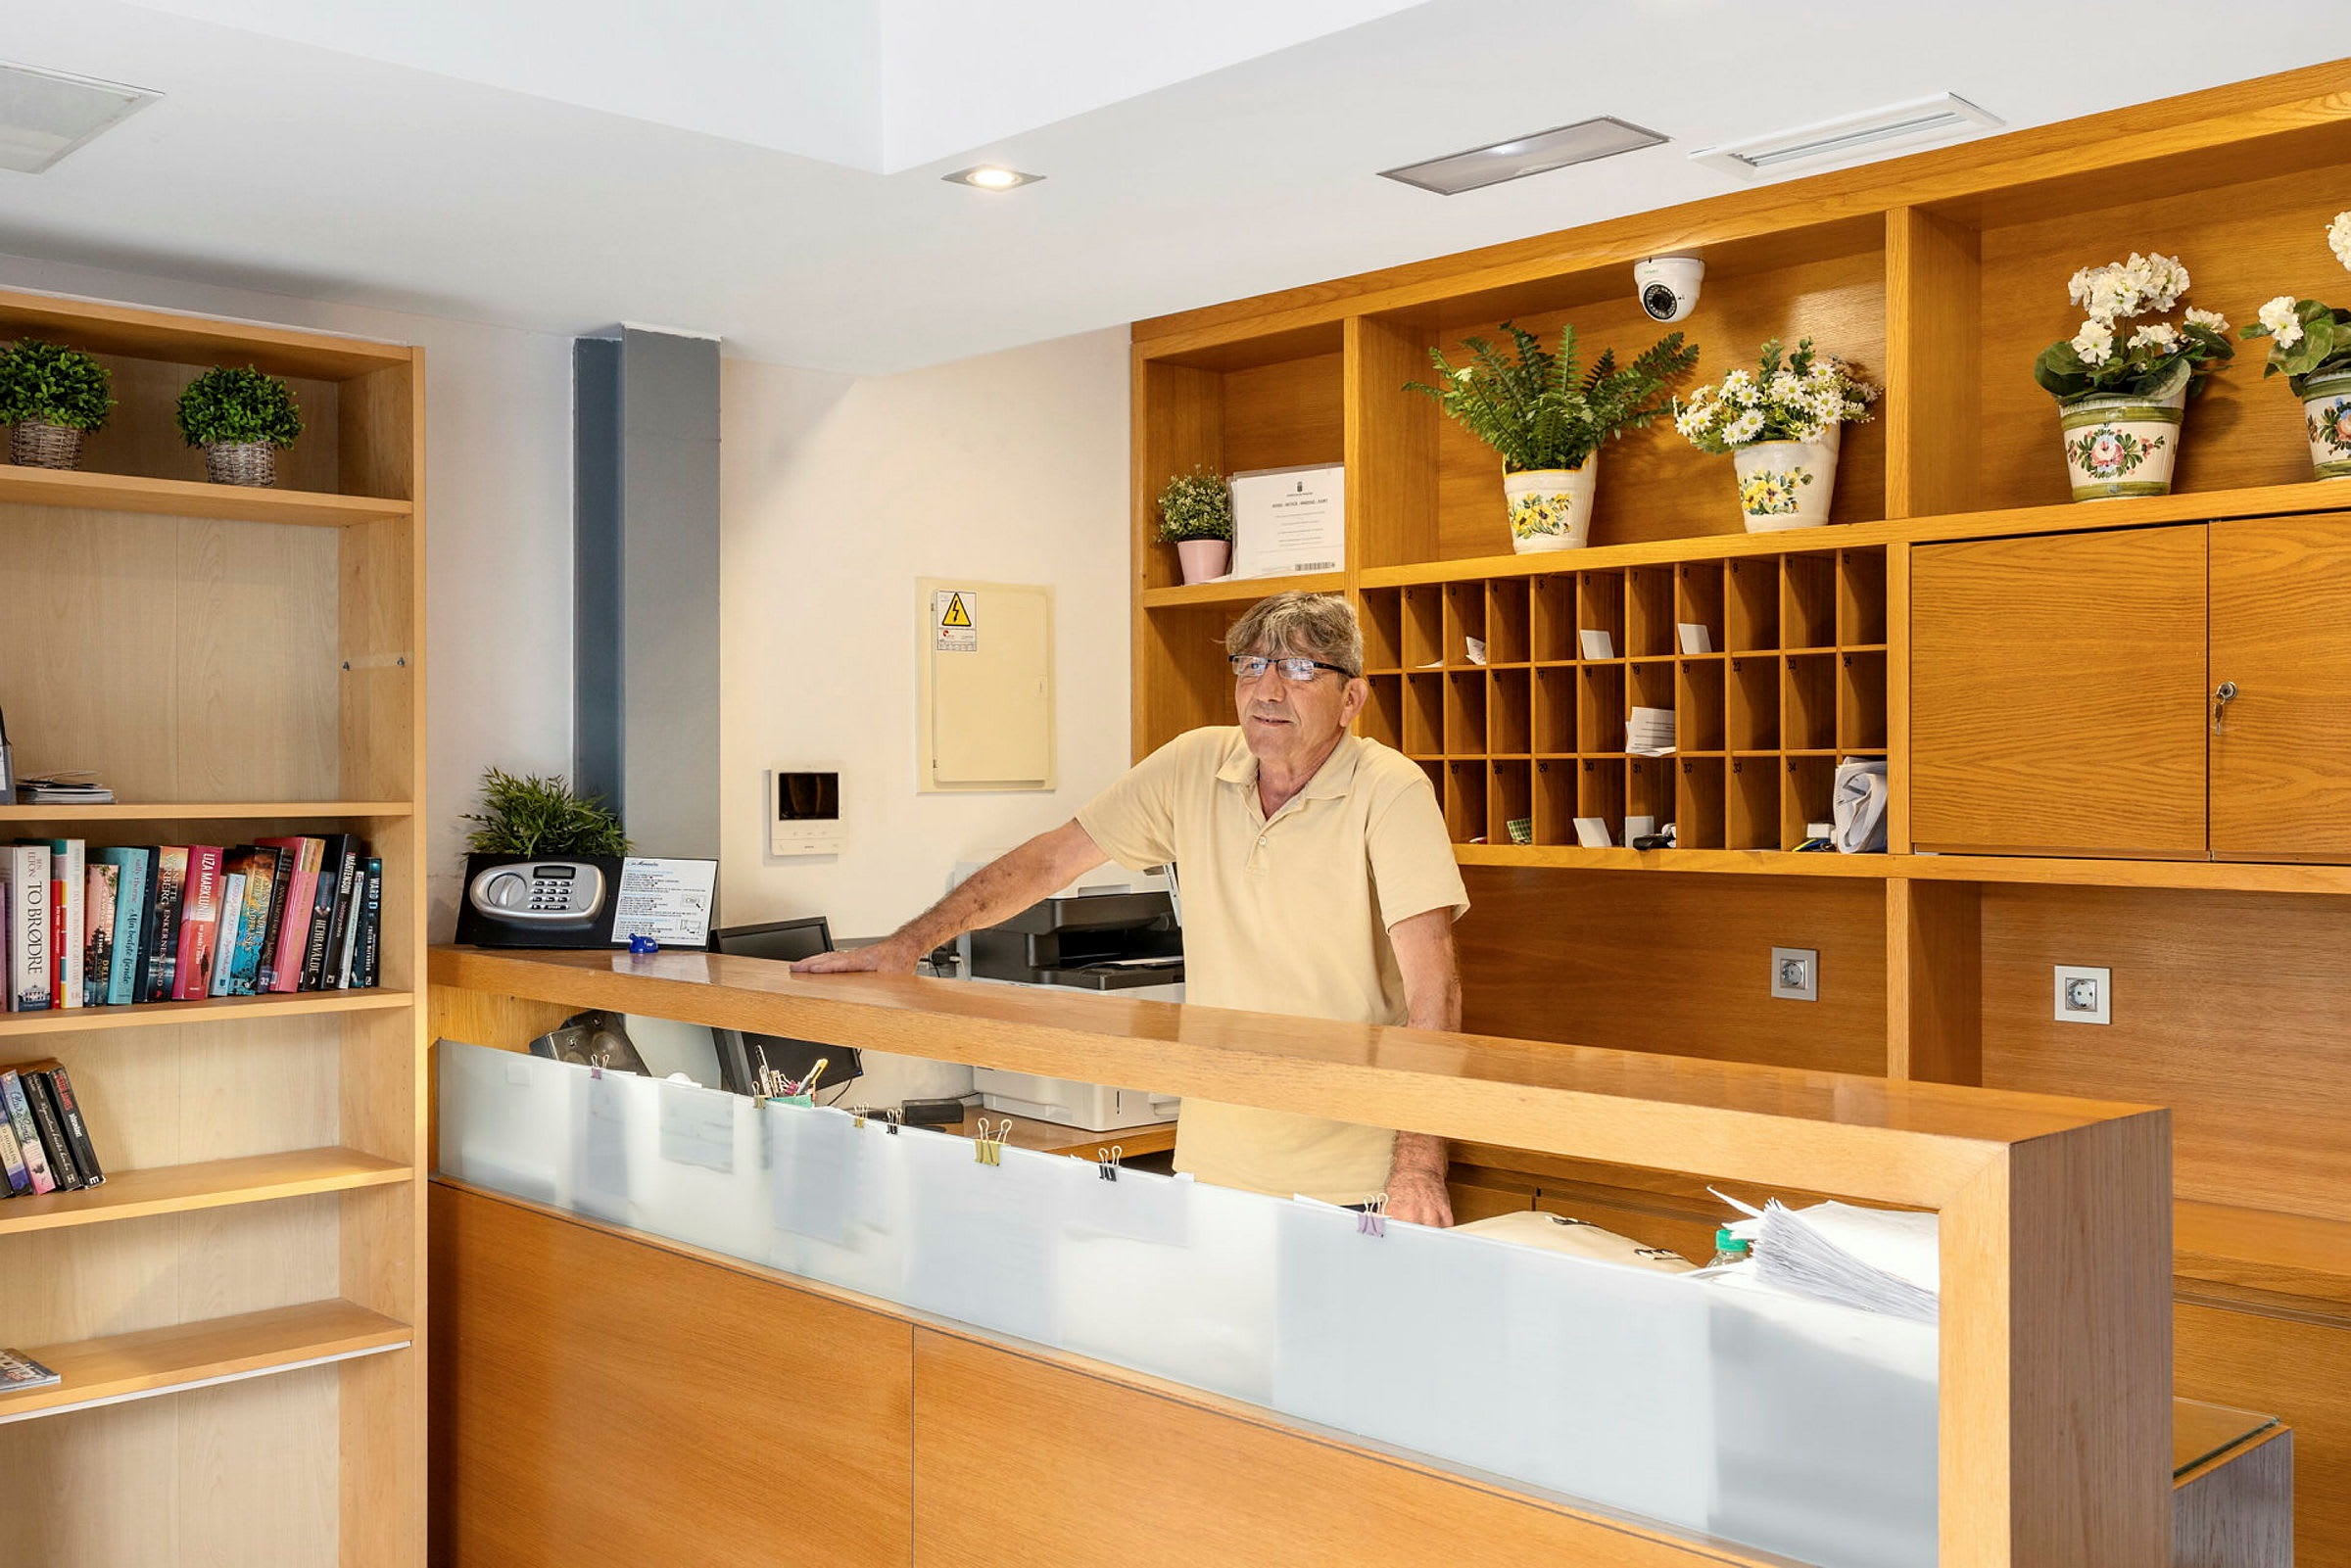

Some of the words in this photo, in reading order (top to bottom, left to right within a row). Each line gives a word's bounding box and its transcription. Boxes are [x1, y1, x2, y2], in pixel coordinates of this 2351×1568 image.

[1733, 563, 1738, 572] 9
[1634, 572, 1638, 582] 7
[1368, 595, 1371, 603] 1
[1408, 591, 1413, 599] 2
[1733, 661, 1741, 671] 22
[1788, 659, 1796, 669] 23
[1844, 657, 1852, 666] 24
[1632, 665, 1640, 675] 19
[1683, 664, 1690, 673] 21
[1451, 764, 1459, 774] 27
[1494, 764, 1503, 774] 28
[1539, 763, 1547, 772] 29
[1585, 762, 1594, 771] 30
[1633, 763, 1641, 773] 31
[1684, 763, 1692, 773] 32
[1734, 763, 1742, 773] 33
[1788, 762, 1797, 772] 34
[201, 853, 216, 871] LIZA
[160, 853, 174, 905] VARBERG
[340, 855, 356, 895] MÅRTENSON
[28, 881, 42, 904] TO
[368, 877, 381, 900] WARD
[196, 872, 214, 921] MARKLUND
[105, 895, 116, 926] WHERE
[368, 901, 379, 910] D
[127, 909, 138, 930] Min
[160, 909, 171, 959] ENKERNES
[28, 909, 43, 974] BRØDRE
[125, 930, 138, 957] bedste
[309, 919, 327, 974] HERRAVÄLDE
[101, 959, 109, 986] DELIA
[18, 1118, 33, 1145] Sandy
